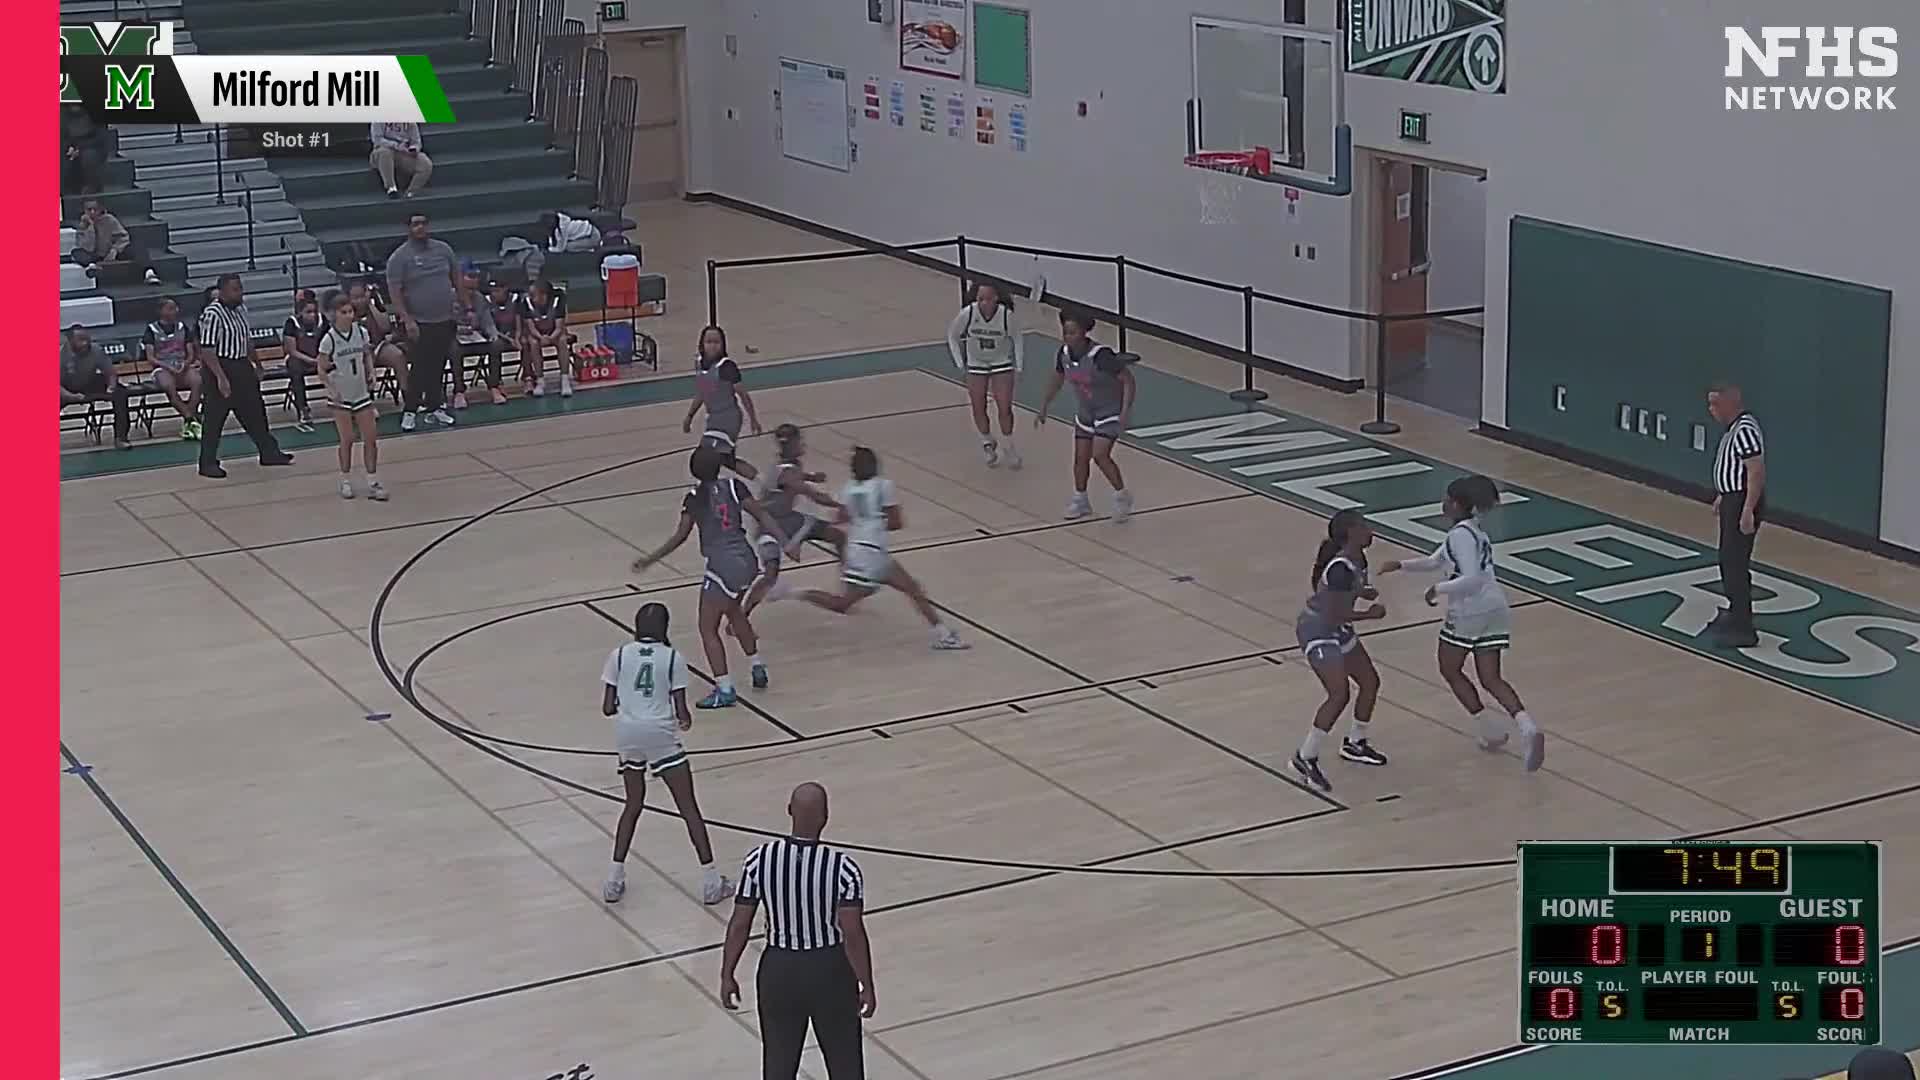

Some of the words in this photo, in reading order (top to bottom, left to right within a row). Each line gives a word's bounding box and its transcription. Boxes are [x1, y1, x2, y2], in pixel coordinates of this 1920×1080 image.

[1404, 115, 1420, 137] EXIT
[350, 357, 358, 377] 1
[1125, 411, 1920, 678] MILLERS
[634, 661, 656, 698] 4
